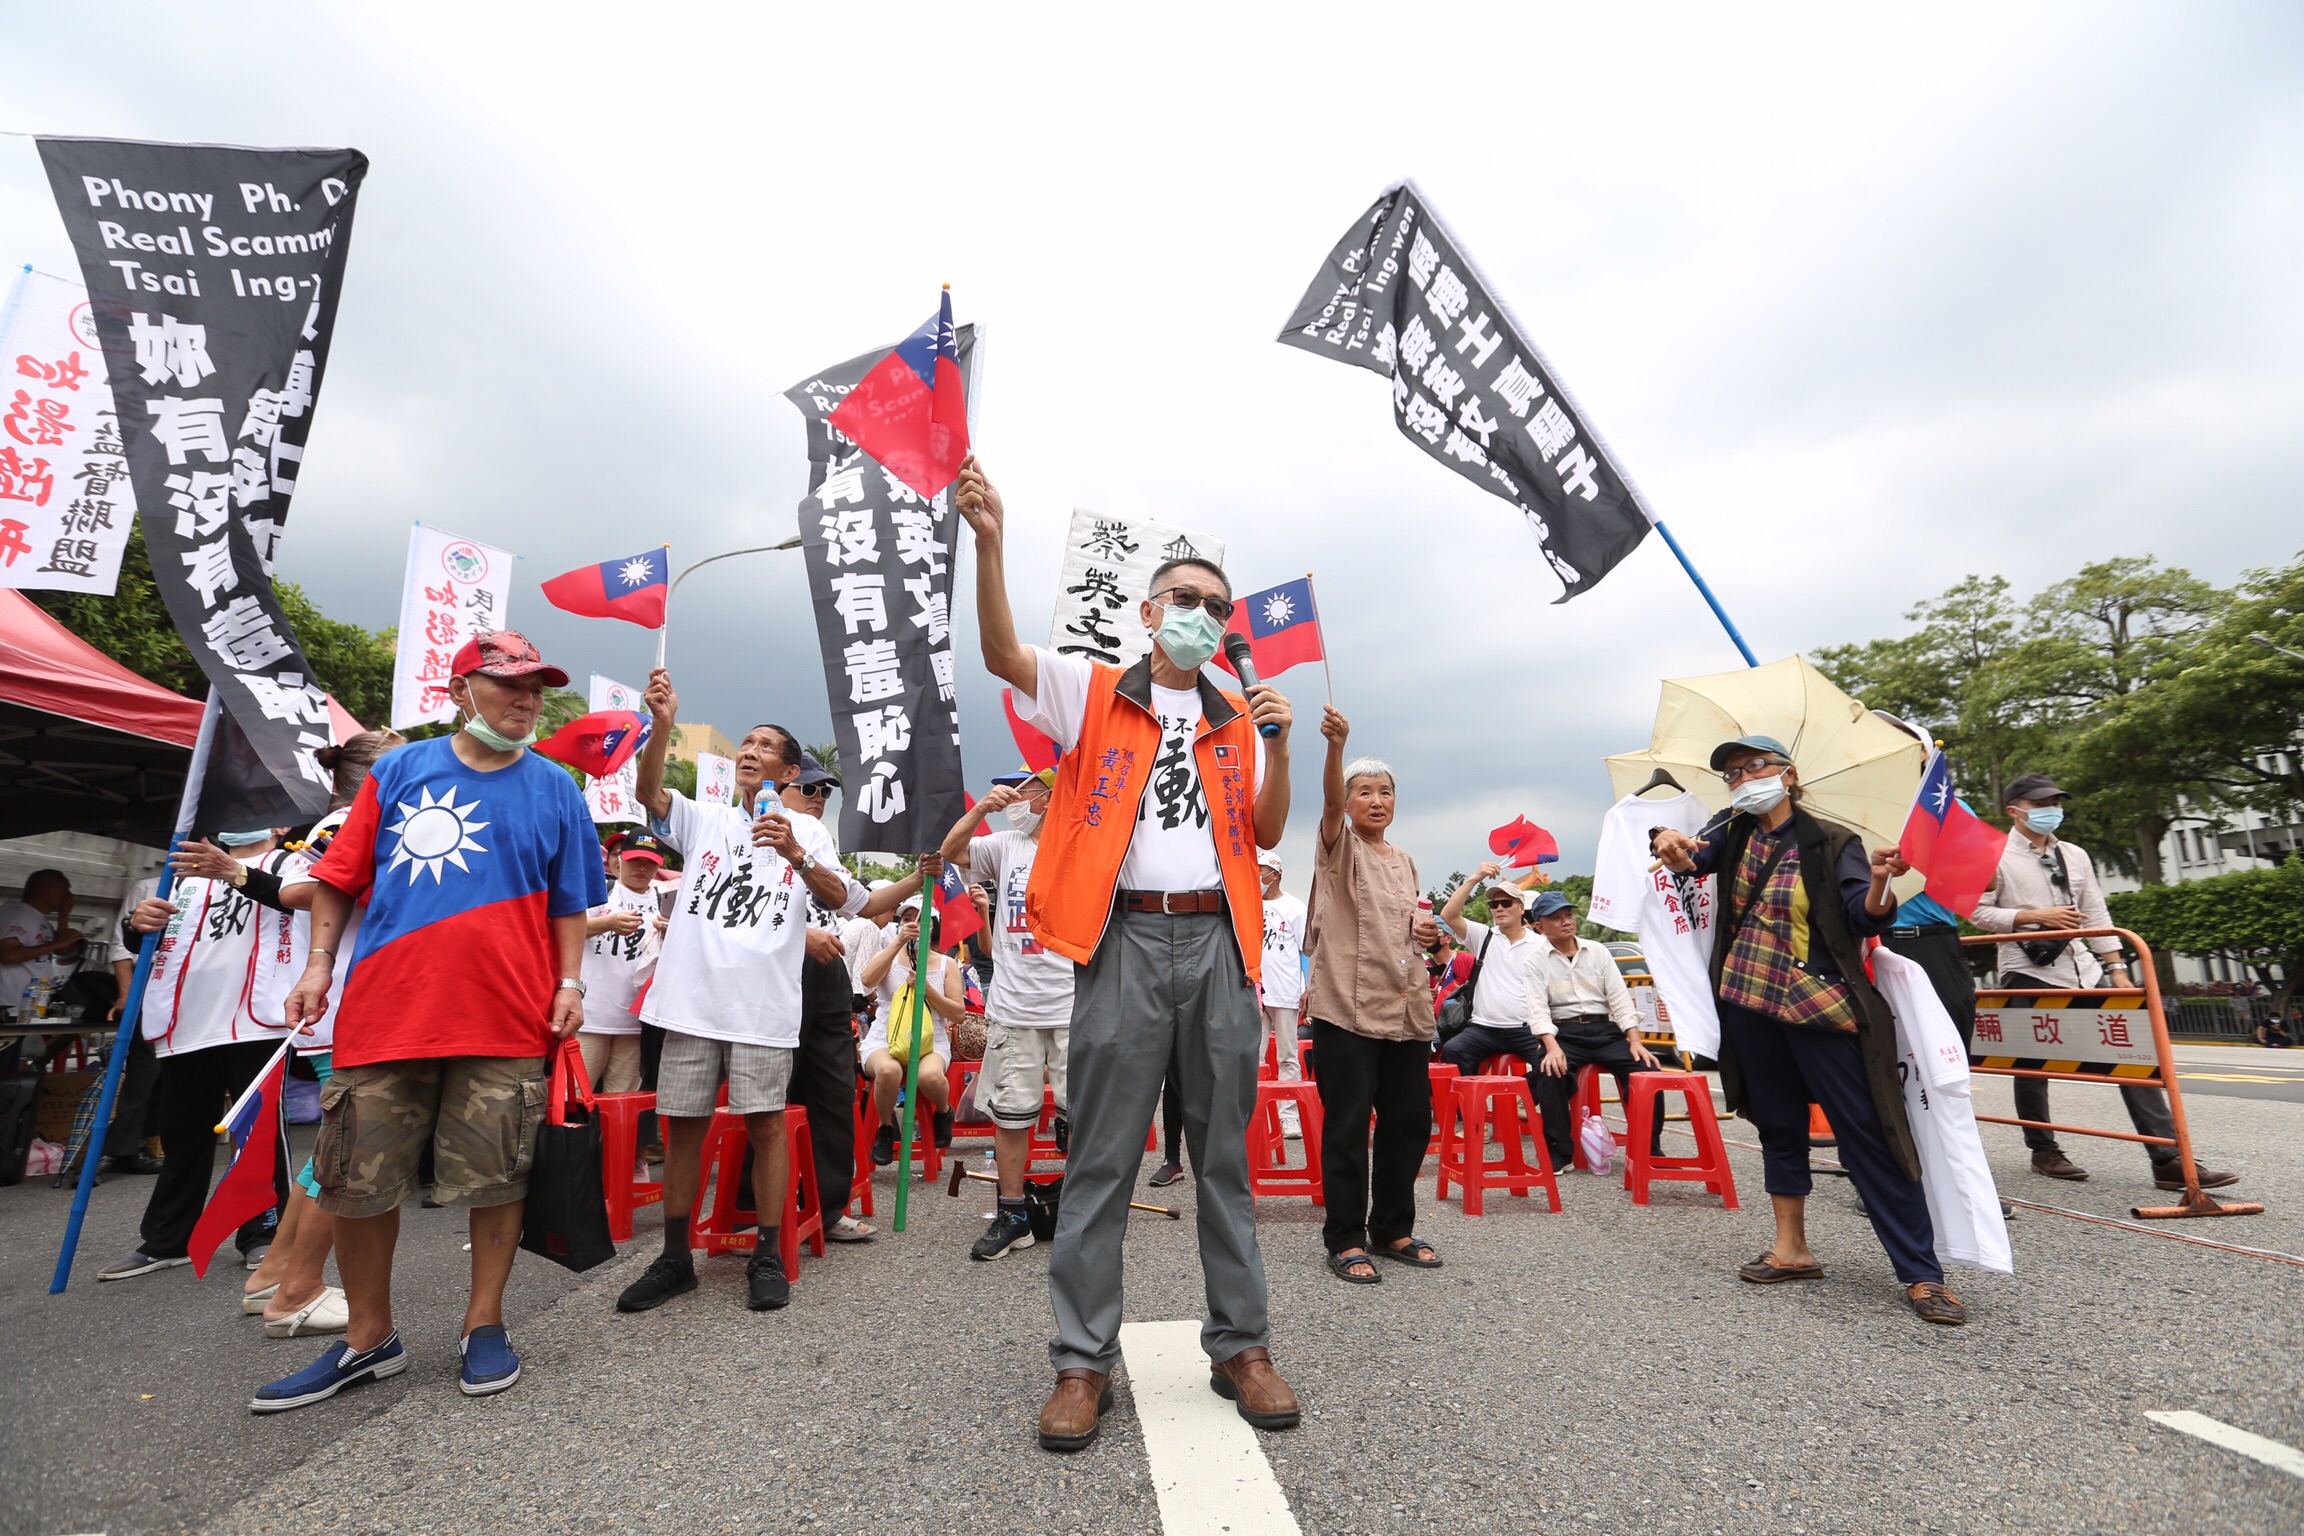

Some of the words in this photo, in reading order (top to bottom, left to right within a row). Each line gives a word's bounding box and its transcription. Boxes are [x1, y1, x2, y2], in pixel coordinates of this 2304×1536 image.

[81, 175, 214, 222] Phony
[239, 182, 301, 214] Ph.
[97, 220, 195, 256] Real
[202, 222, 339, 258] Scamm
[108, 260, 200, 297] Tsai
[1345, 307, 1374, 351] Tsai
[1366, 205, 1415, 294] Ing-wen
[1301, 282, 1351, 338] Phony
[1324, 300, 1358, 346] Real
[1083, 747, 1121, 827] 黃正忠
[687, 850, 720, 916] 假民主
[1653, 868, 1691, 935] 反貪腐
[1974, 1012, 2134, 1049] 輛改道
[2116, 1052, 2153, 1062] 103-122
[719, 1236, 748, 1248] 貝斯特
